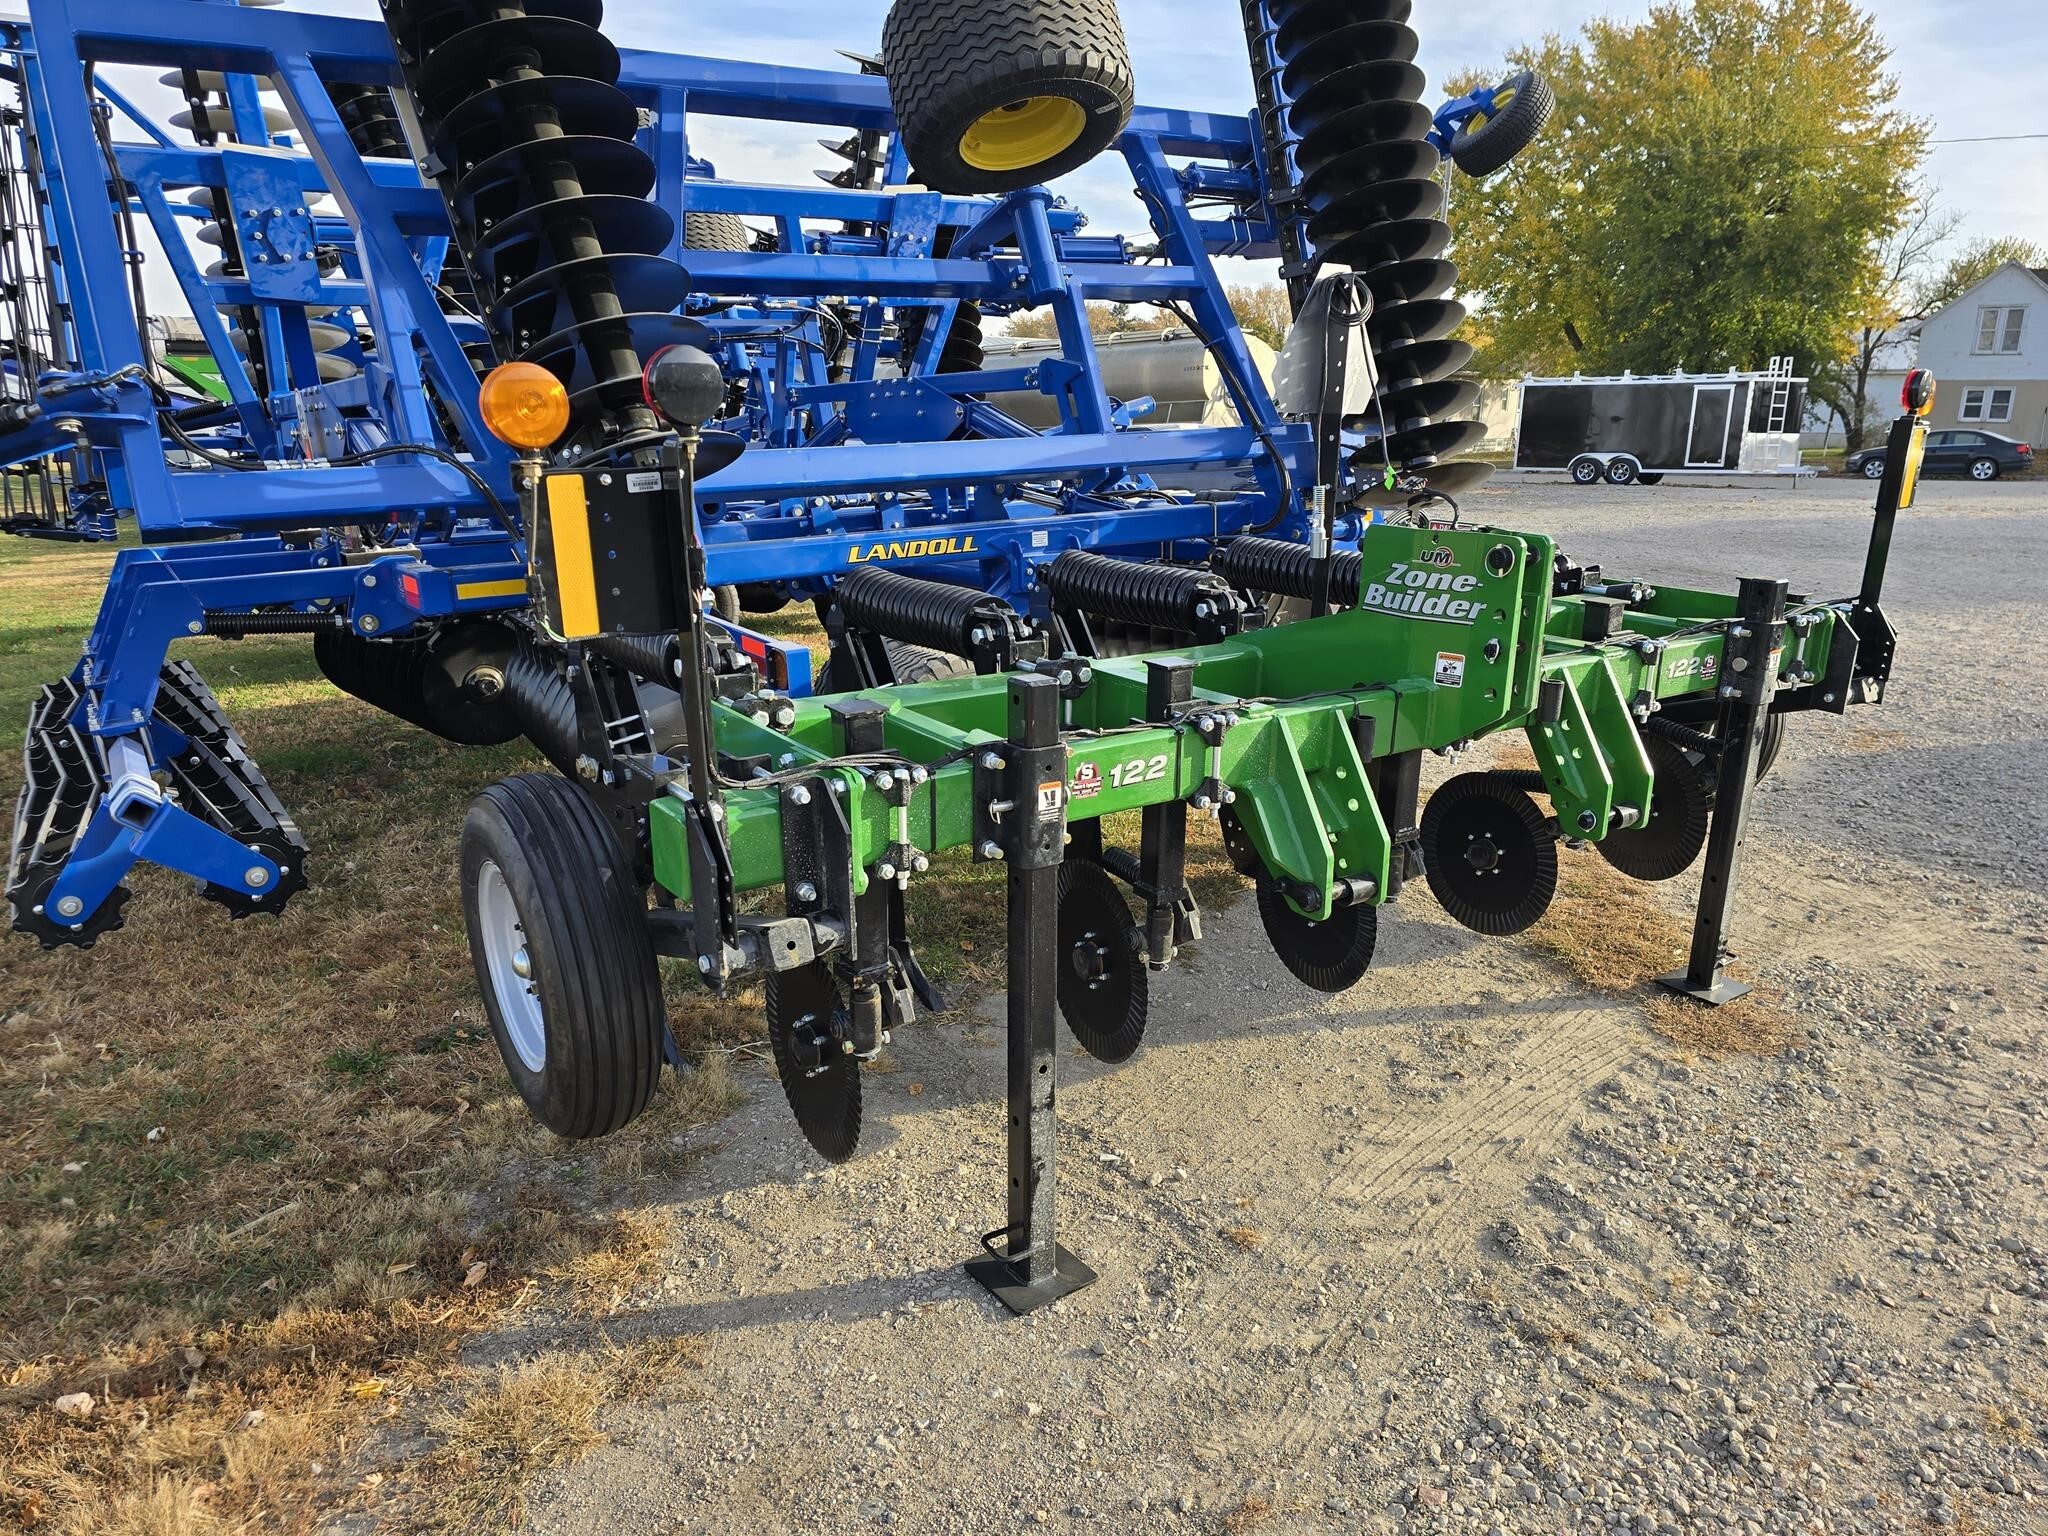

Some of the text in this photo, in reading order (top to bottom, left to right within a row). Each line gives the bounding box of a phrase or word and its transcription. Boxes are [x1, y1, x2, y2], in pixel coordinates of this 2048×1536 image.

[848, 536, 979, 564] LANDOLL
[1364, 583, 1488, 619] Builder
[1668, 656, 1701, 680] 122
[1108, 754, 1169, 789] 122
